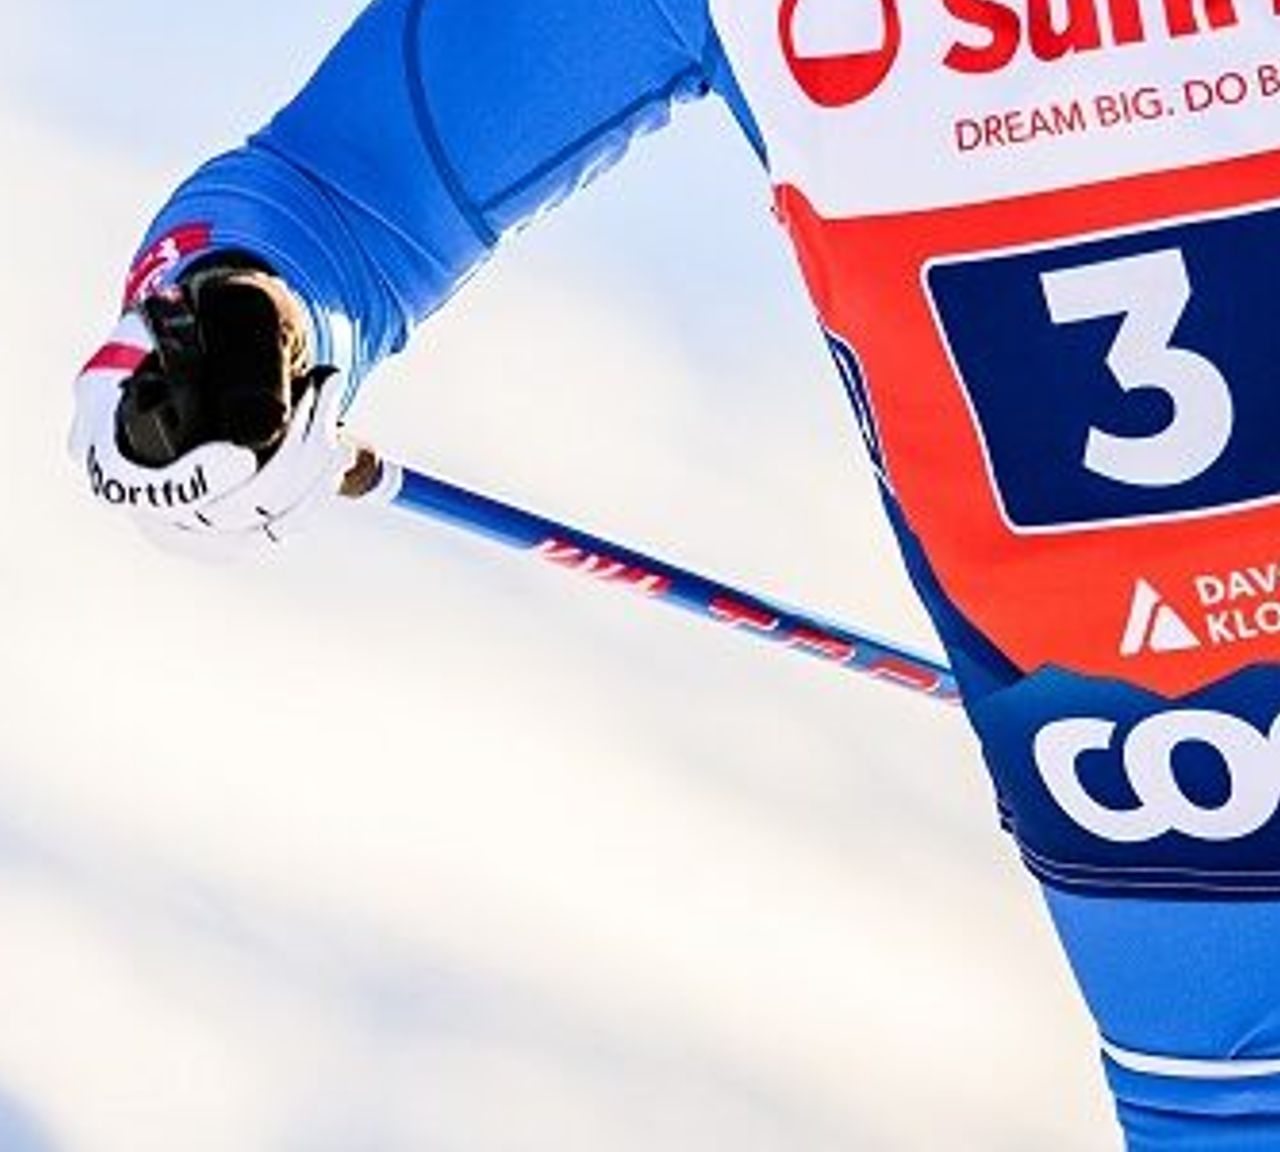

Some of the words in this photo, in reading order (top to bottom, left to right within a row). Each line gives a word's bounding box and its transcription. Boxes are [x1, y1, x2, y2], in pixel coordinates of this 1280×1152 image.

[954, 99, 1087, 152] DREAM
[1095, 86, 1176, 128] BIG.
[1183, 71, 1248, 113] DO
[1039, 248, 1234, 486] 3
